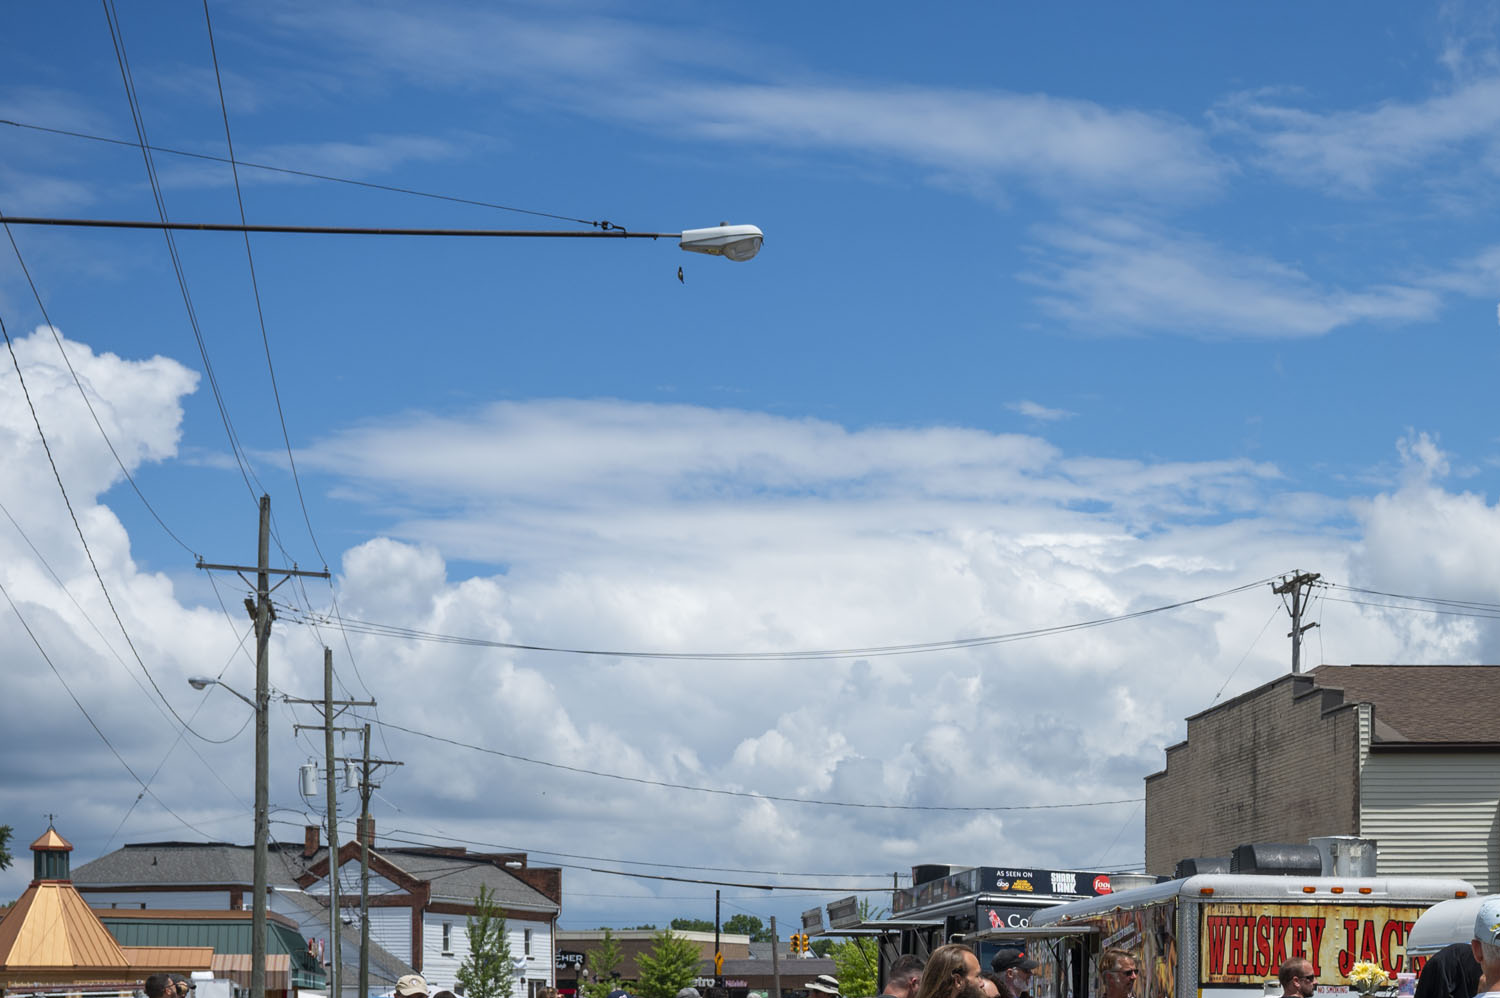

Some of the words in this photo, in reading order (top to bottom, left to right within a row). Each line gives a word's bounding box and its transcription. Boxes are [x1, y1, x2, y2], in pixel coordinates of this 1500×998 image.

[1051, 873, 1076, 882] SHARK
[1051, 882, 1077, 893] TANK
[1207, 915, 1326, 977] WHISKEY
[1327, 986, 1349, 994] SMOKING
